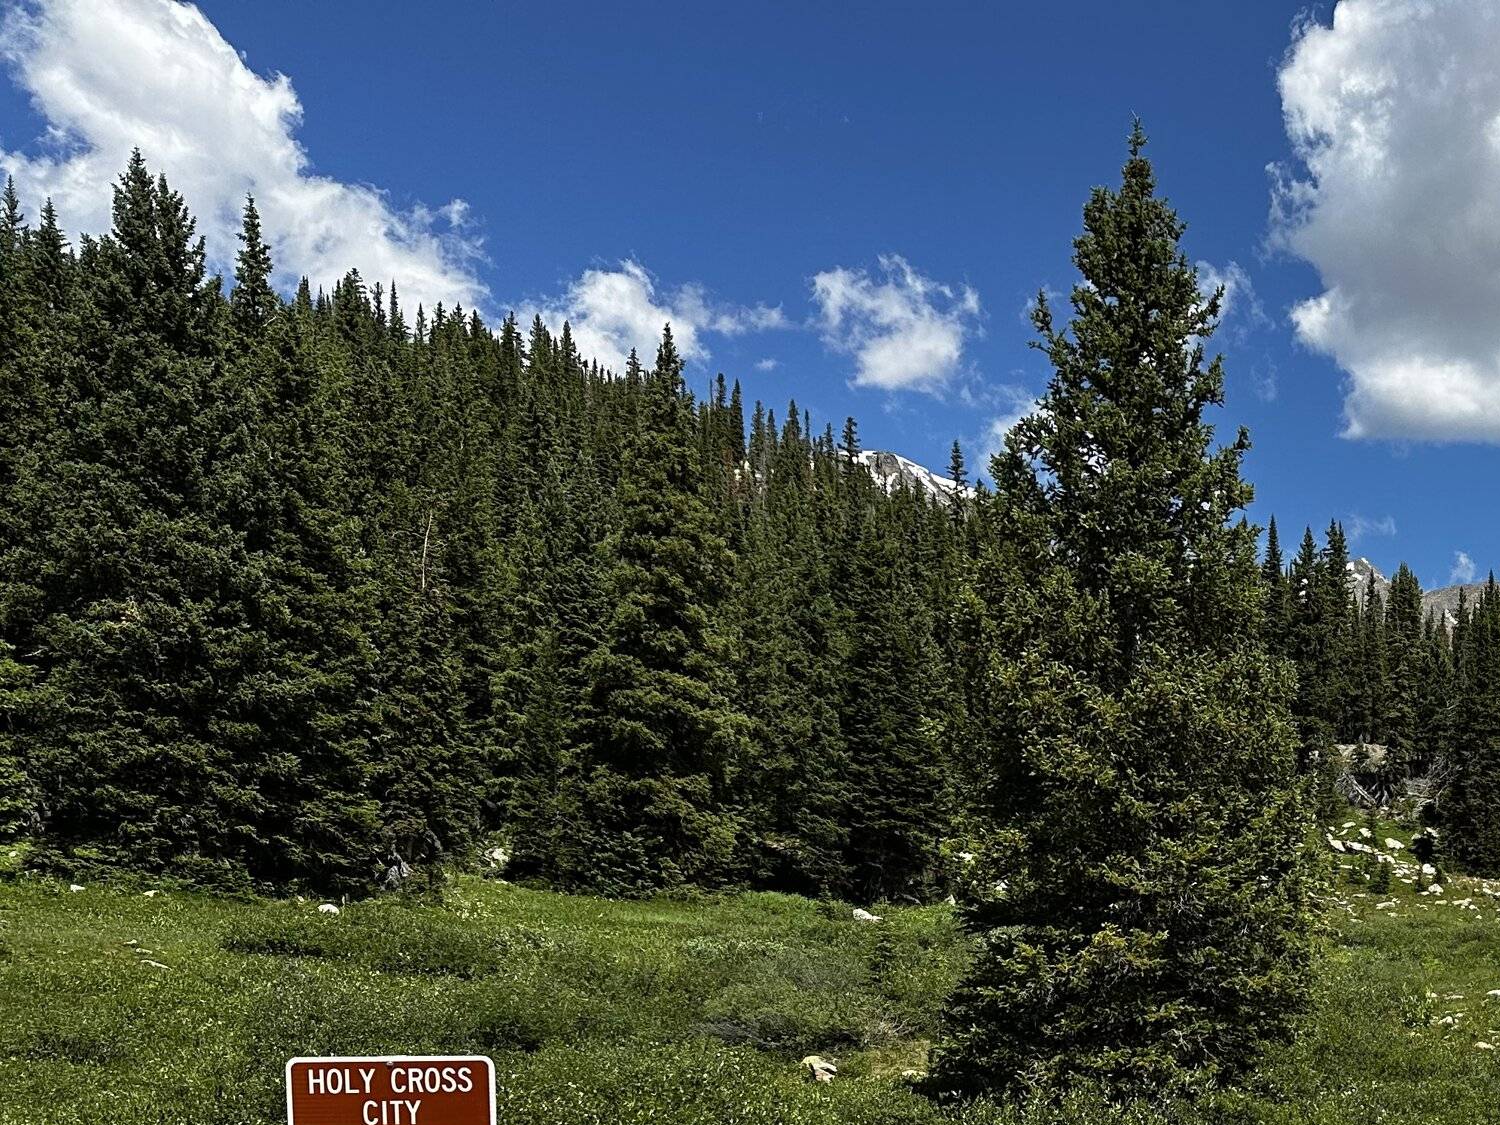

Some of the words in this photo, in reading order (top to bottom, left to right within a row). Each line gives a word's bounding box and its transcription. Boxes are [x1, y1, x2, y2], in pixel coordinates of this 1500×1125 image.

[308, 1068, 375, 1094] HOLY
[391, 1067, 473, 1093] CROSS
[363, 1100, 421, 1125] CITY
